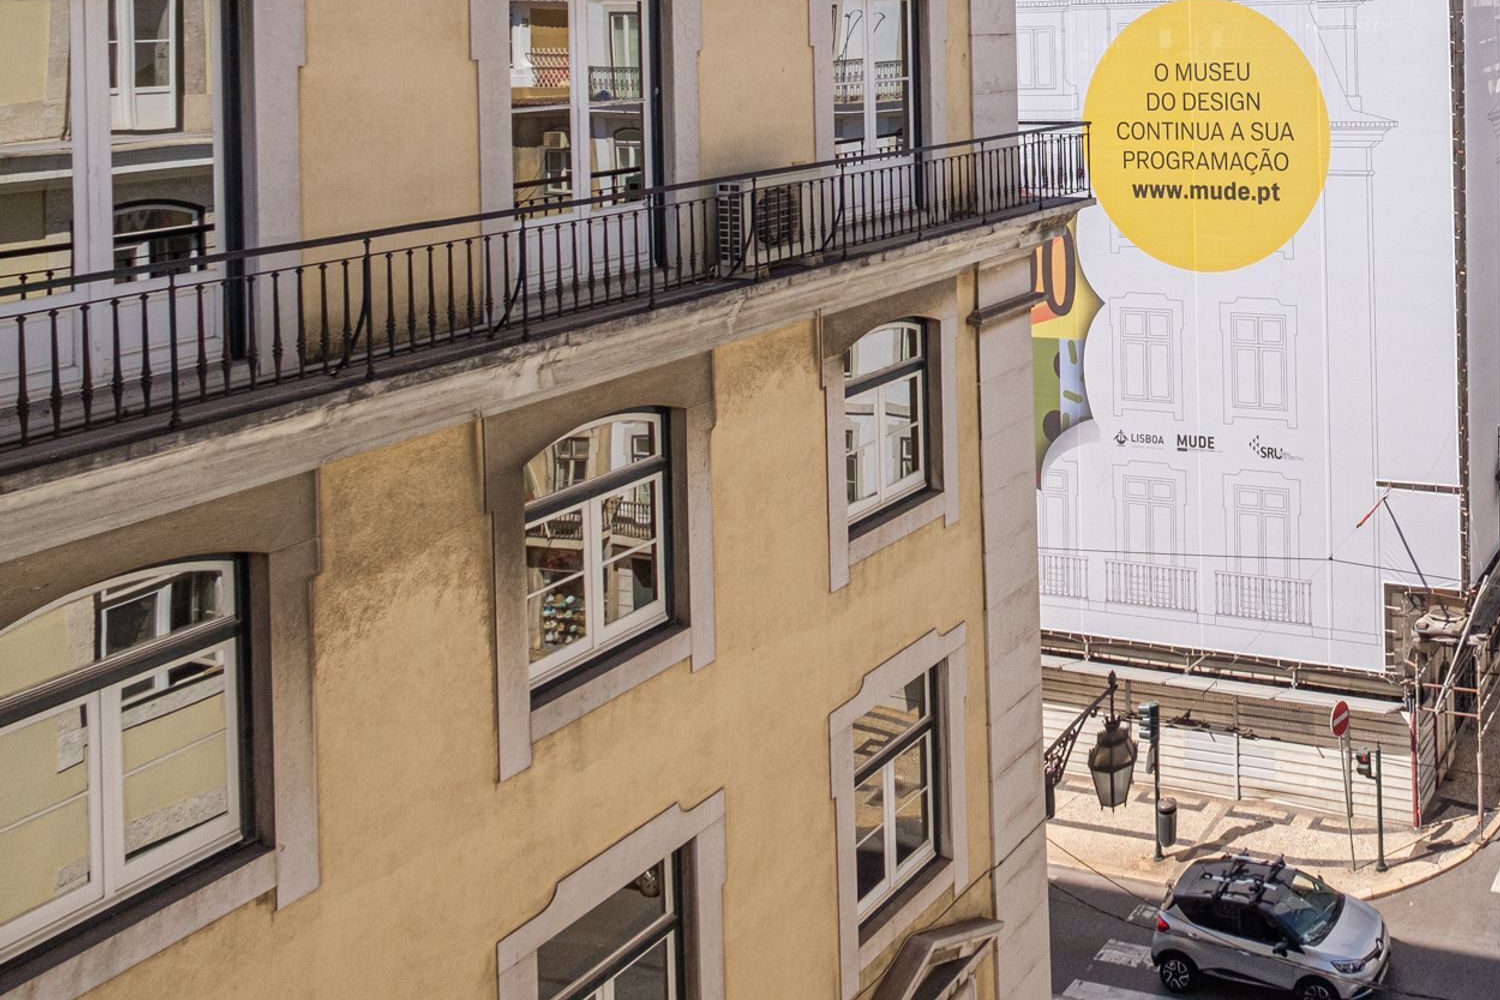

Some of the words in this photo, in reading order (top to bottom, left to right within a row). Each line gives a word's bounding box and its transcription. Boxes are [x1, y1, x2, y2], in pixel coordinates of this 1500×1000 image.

[1153, 62, 1170, 82] O
[1174, 61, 1251, 82] MUSEU
[1145, 92, 1177, 112] DO
[1182, 92, 1261, 112] DESIGN
[1116, 120, 1227, 142] CONTINUA
[1230, 122, 1245, 141] A
[1249, 121, 1295, 142] SUA
[1122, 148, 1290, 176] PROGRAMAÇÃO
[1132, 180, 1281, 205] www.mude.pt
[1130, 433, 1165, 445] LISBOA
[1176, 433, 1215, 450] MUDE
[1259, 446, 1283, 460] SRU
